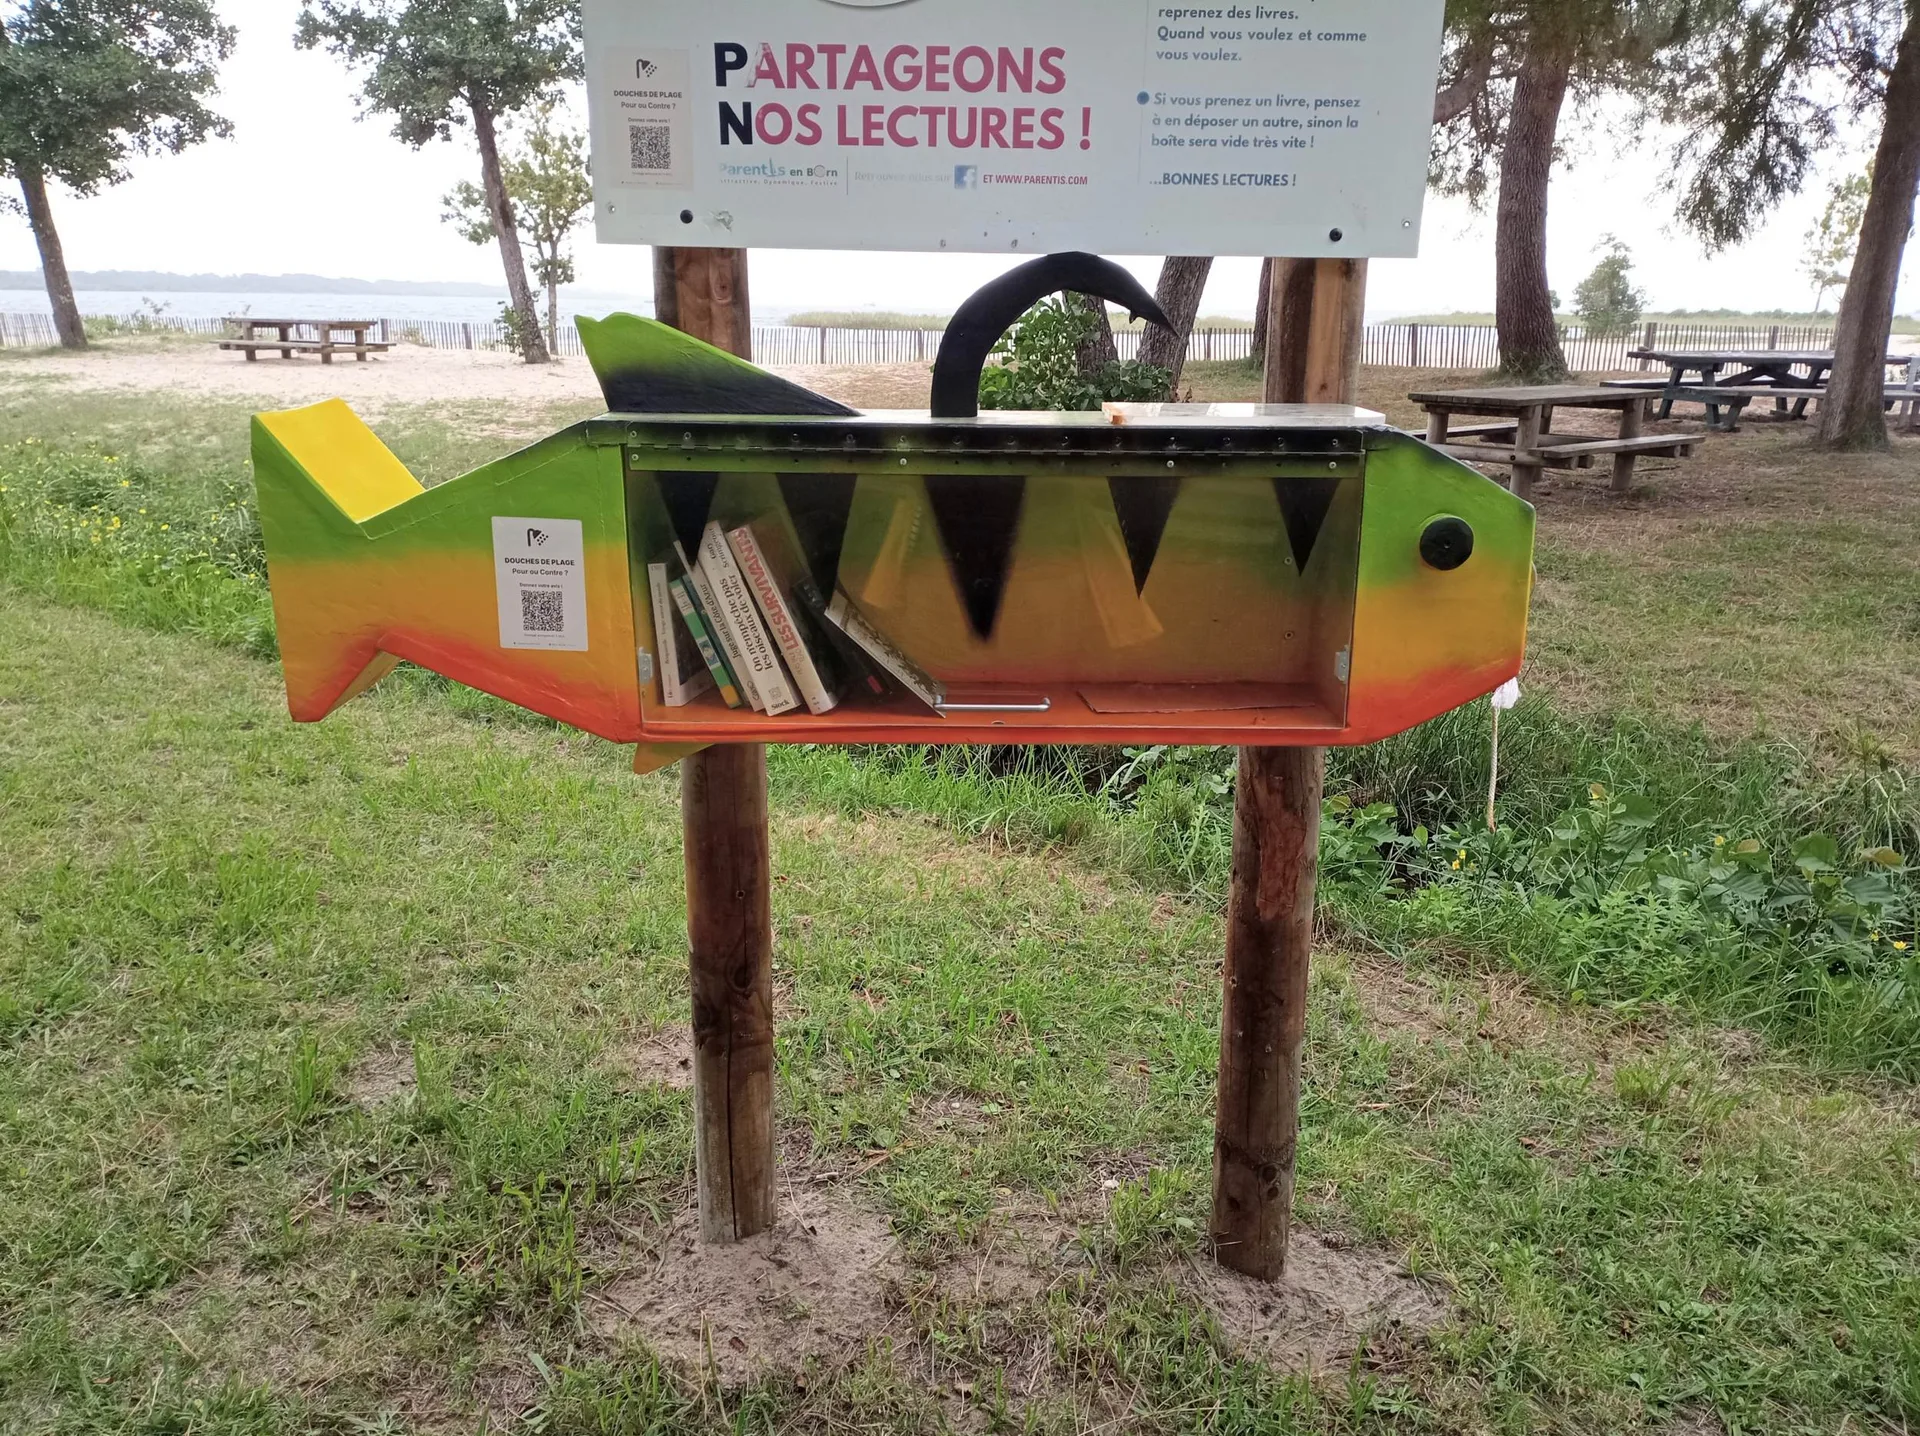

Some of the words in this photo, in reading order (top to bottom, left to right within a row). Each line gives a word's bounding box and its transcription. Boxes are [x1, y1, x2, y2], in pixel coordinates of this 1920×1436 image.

[1158, 8, 1223, 21] reprenez
[1227, 5, 1251, 19] des
[1256, 6, 1299, 19] livres.
[1157, 26, 1204, 41] Quand
[1210, 30, 1242, 40] vous
[1248, 27, 1293, 40] voulez
[1298, 29, 1312, 41] et
[1317, 31, 1367, 42] comme
[1156, 50, 1188, 61] vous
[1192, 48, 1242, 61] voulez.
[714, 42, 1067, 94] PARTAGEONS
[613, 90, 648, 98] DOUCHES
[659, 91, 682, 99] PLAGE
[1153, 92, 1166, 105] Si
[1170, 96, 1201, 106] vous
[1205, 96, 1251, 109] prenez
[1255, 97, 1272, 107] un
[1276, 94, 1310, 109] livre,
[1314, 98, 1361, 110] pensez
[719, 101, 822, 147] NOS
[838, 104, 1065, 150] LECTURES
[1080, 107, 1091, 150] !
[1152, 114, 1161, 126] à
[1165, 117, 1181, 126] en
[1184, 114, 1238, 129] déposer
[1242, 118, 1259, 127] un
[1263, 116, 1303, 130] autre,
[1307, 116, 1342, 128] sinon
[1346, 115, 1359, 128] la
[1152, 133, 1185, 147] boîte
[1188, 137, 1217, 147] sera
[1222, 135, 1249, 147] vide
[1253, 135, 1278, 148] très
[1282, 135, 1306, 148] vite
[1310, 136, 1315, 148] !
[790, 168, 804, 177] en
[983, 174, 994, 183] ET
[995, 174, 1088, 185] WWW.PARENTIS.COM
[1222, 173, 1289, 186] LECTURES
[1292, 174, 1297, 186] !
[504, 557, 540, 565] DOUCHES
[732, 527, 786, 624] SURVIVANTS
[699, 583, 714, 606] d'Azur
[719, 578, 734, 598] pas
[727, 574, 743, 600] voler
[710, 605, 722, 623] Côte
[739, 600, 749, 614] de
[721, 630, 732, 642] sur
[745, 614, 766, 654] oiseaux
[775, 619, 799, 650] LES
[728, 640, 741, 659] Juge
[752, 656, 763, 672] On
[761, 654, 773, 670] les
[771, 699, 789, 711] Stock
